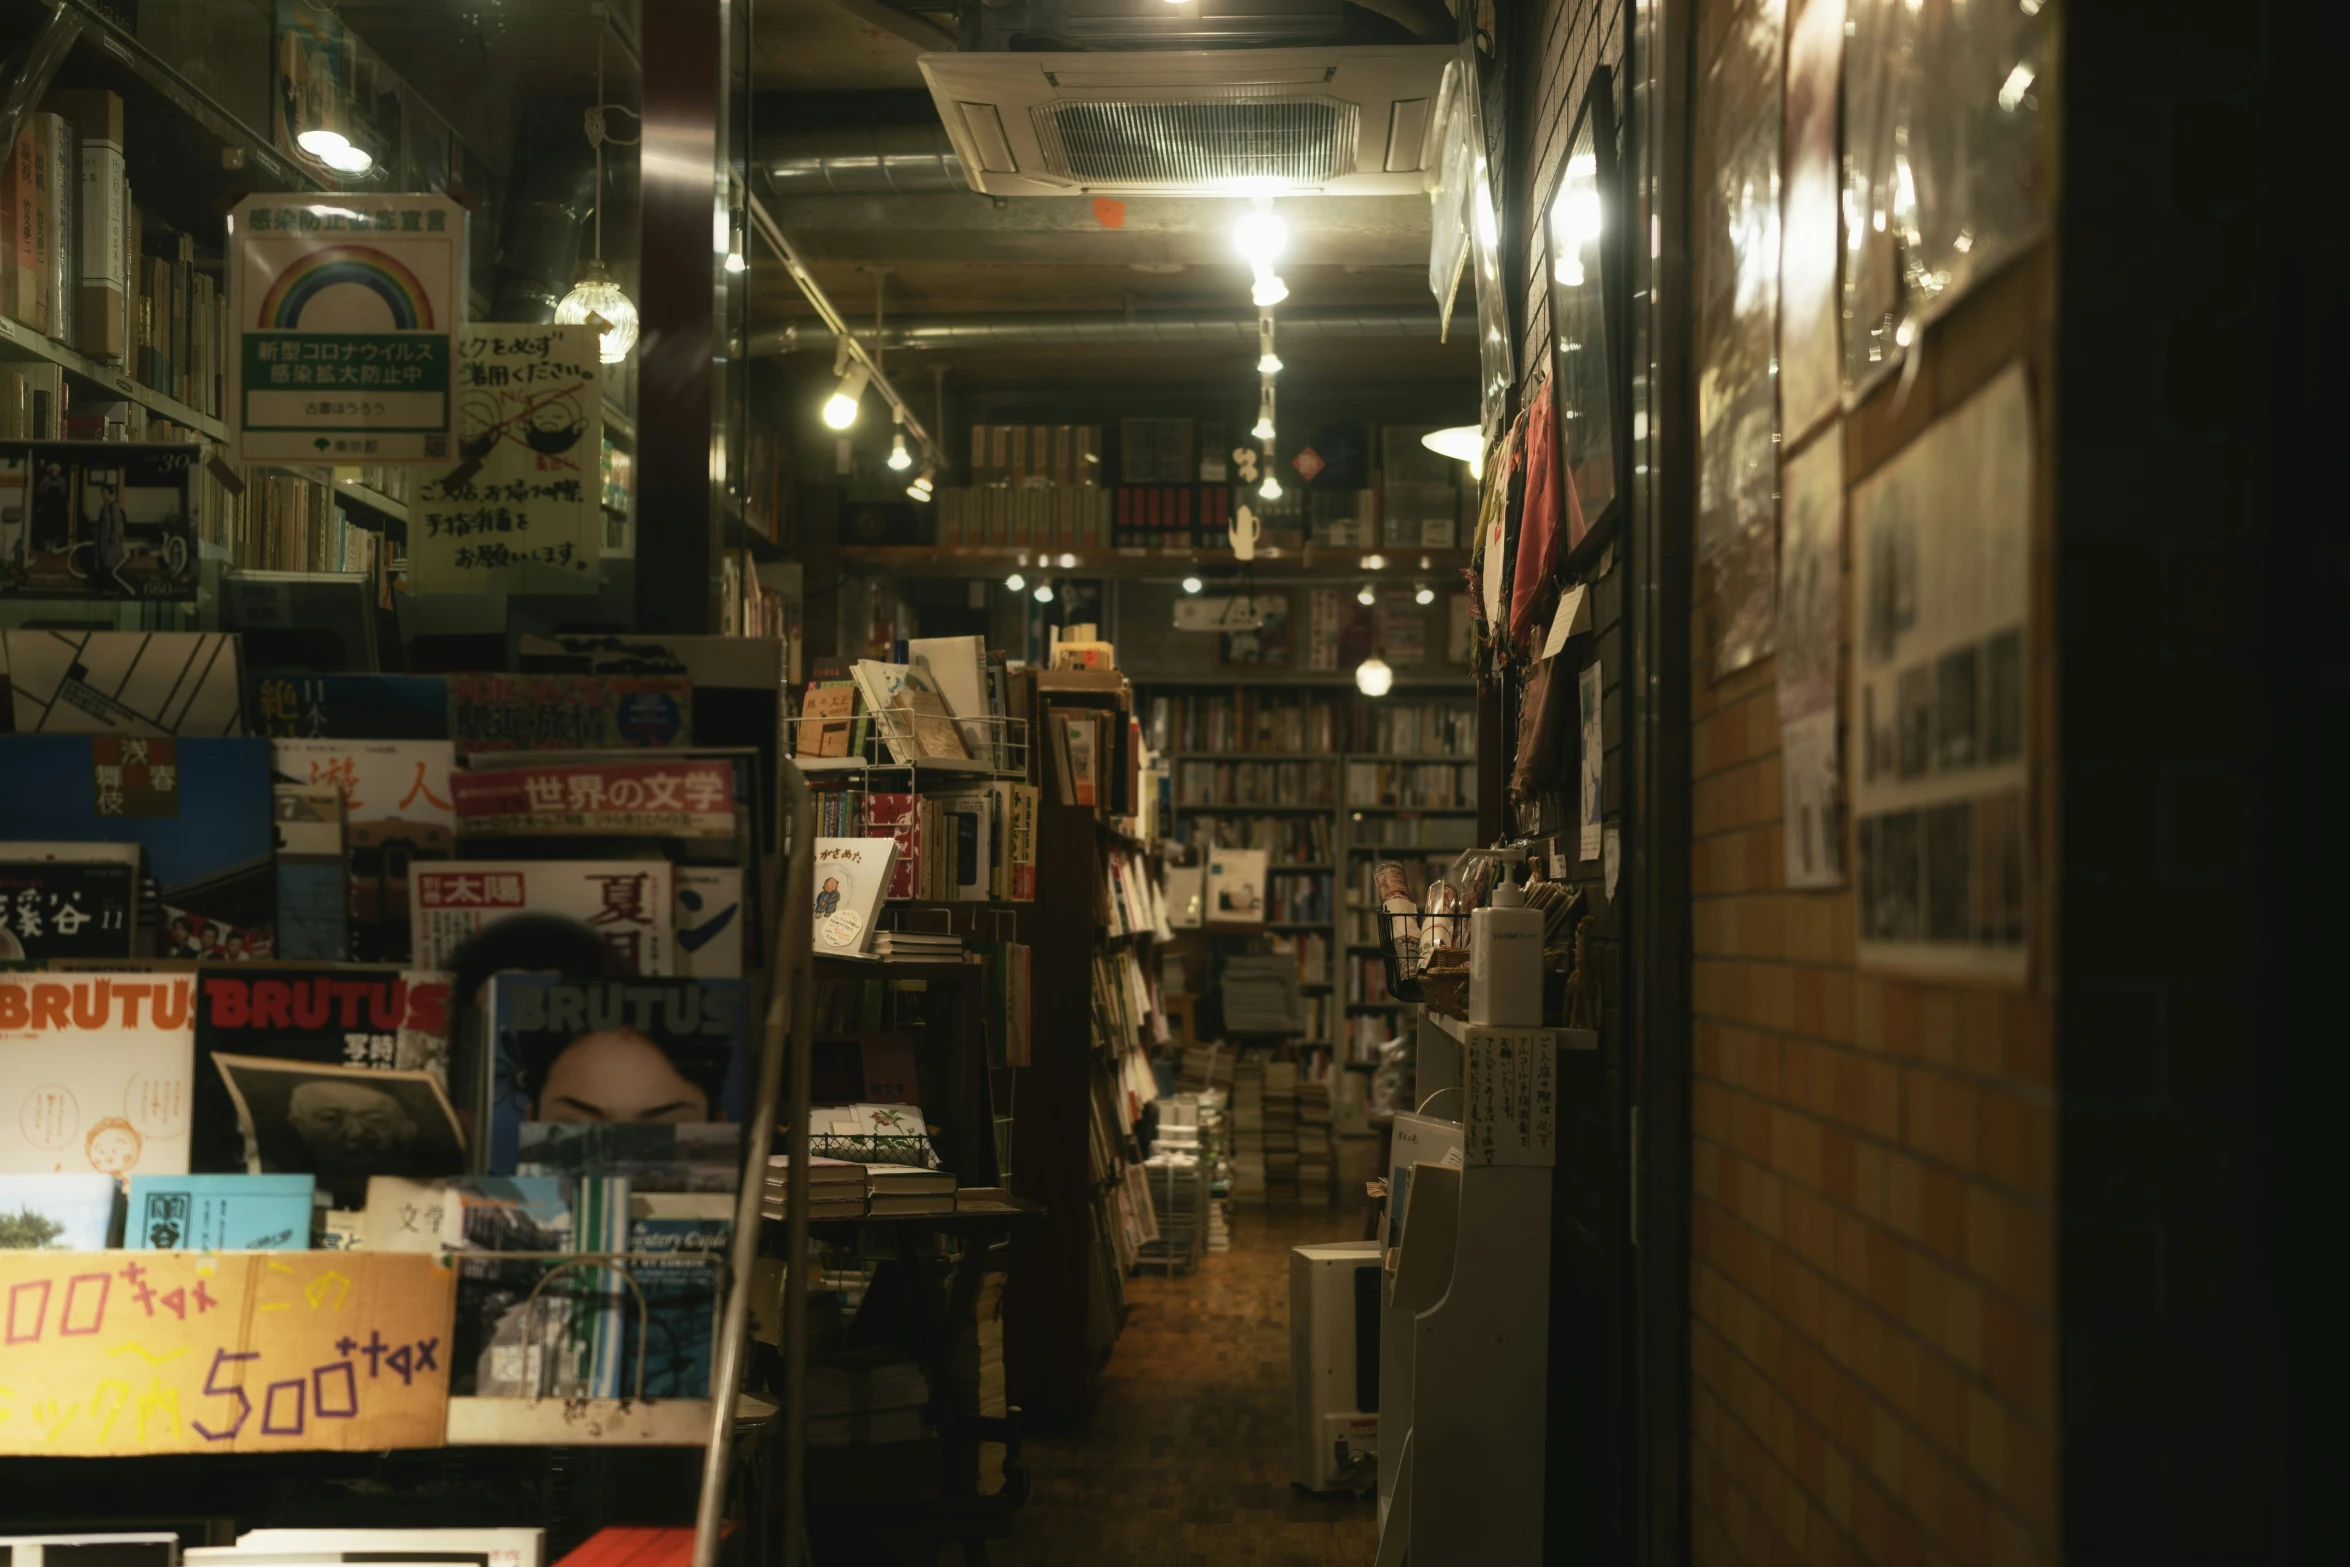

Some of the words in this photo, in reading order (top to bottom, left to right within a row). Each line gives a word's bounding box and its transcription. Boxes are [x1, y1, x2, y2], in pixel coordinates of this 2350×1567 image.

[257, 340, 434, 363] 新型コロナウイルス
[269, 363, 423, 385] 感染拡大防止中
[333, 438, 380, 455] 東京都
[522, 770, 726, 812] 世界の文学
[443, 875, 523, 904] 太陽
[0, 975, 197, 1031] BRUTU
[204, 976, 450, 1031] BRUTUS
[508, 981, 735, 1035] BRUTUS
[399, 1203, 445, 1233] 文学
